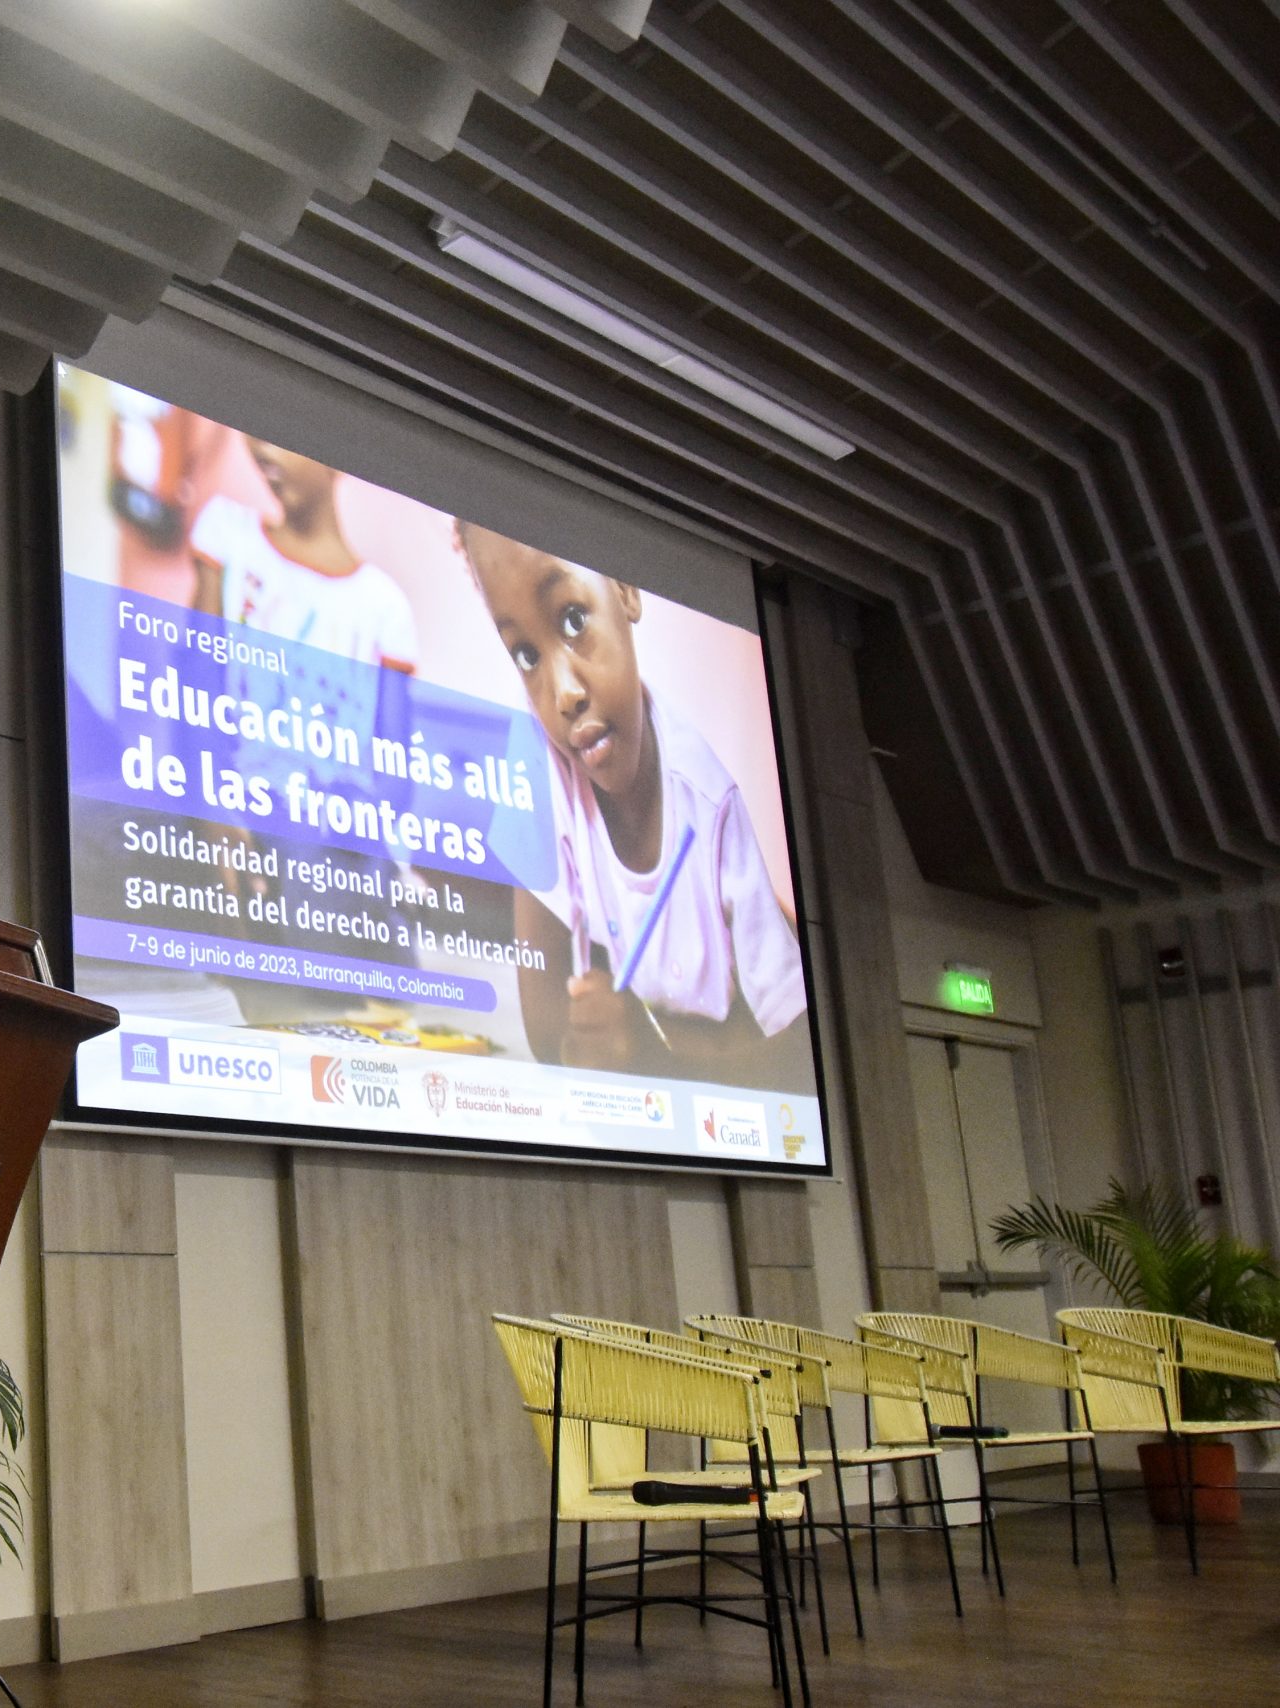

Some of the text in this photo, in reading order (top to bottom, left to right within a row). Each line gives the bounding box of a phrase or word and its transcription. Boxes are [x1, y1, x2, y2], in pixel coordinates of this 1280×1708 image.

[119, 601, 288, 676] Foro regional
[120, 657, 534, 812] Educación más allá
[121, 735, 486, 864] de las fronteras
[123, 821, 464, 914] Solidaridad regional para la
[125, 877, 546, 971] garantía del derecho a la educación
[127, 933, 464, 1001] 7-9 de junio de 2023, Barranquilla, Colombia
[959, 980, 991, 1004] SALIDA
[179, 1052, 272, 1082] unesco
[351, 1059, 398, 1074] COLOMBIA
[352, 1084, 401, 1109] VIDA
[454, 1081, 510, 1098] Ministerio de
[456, 1097, 542, 1116] Educación Nacional
[721, 1125, 760, 1146] Canada
